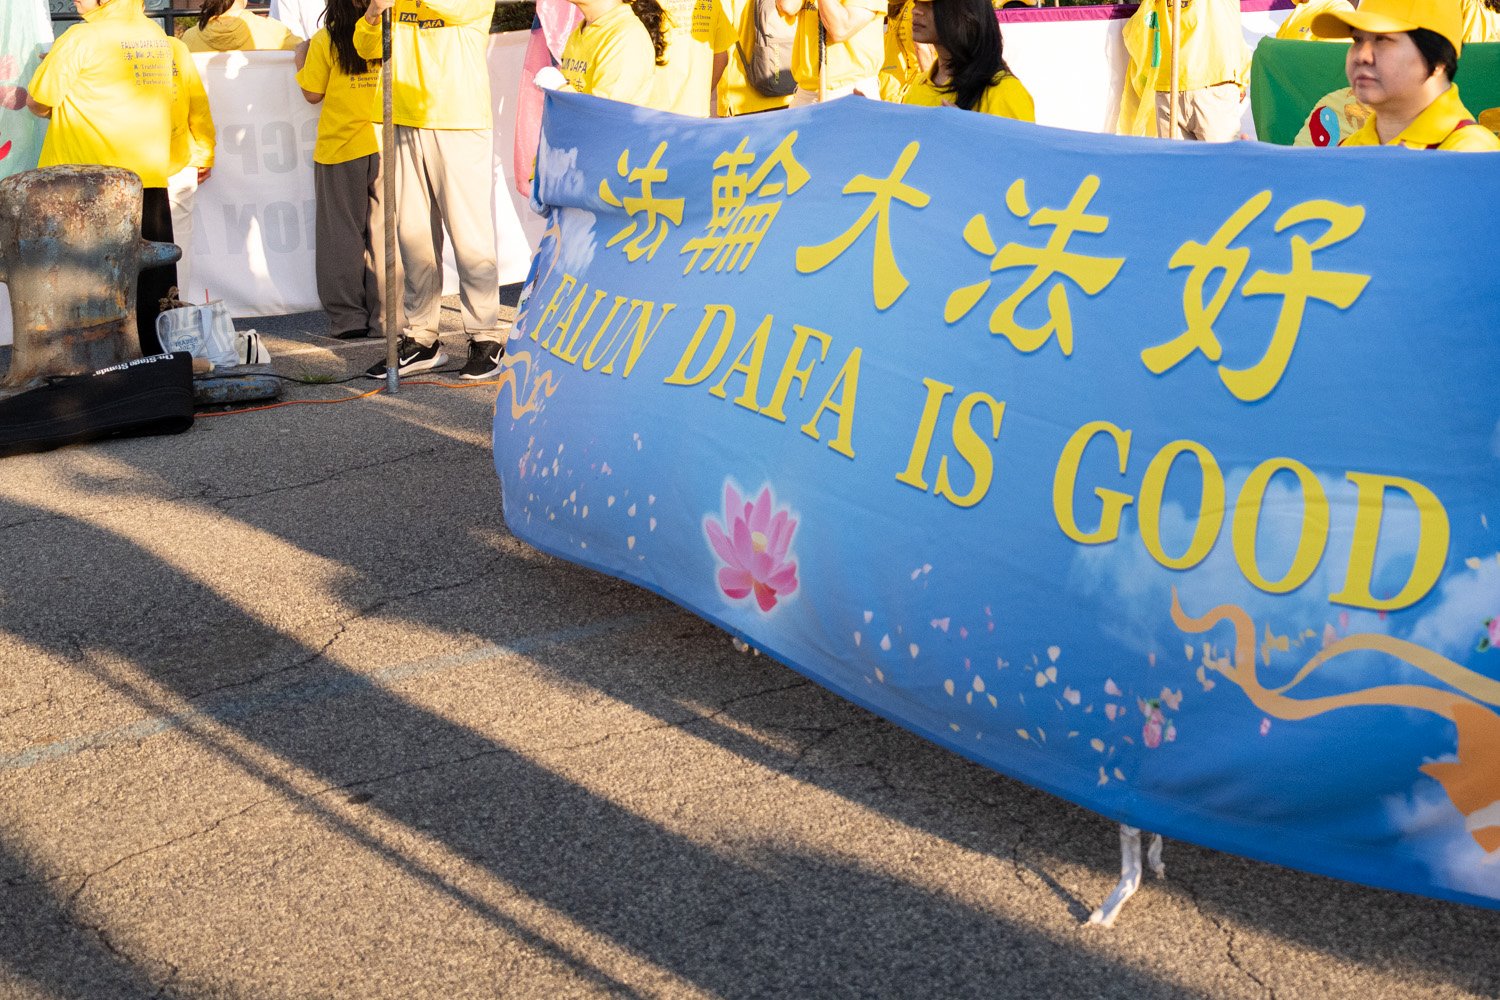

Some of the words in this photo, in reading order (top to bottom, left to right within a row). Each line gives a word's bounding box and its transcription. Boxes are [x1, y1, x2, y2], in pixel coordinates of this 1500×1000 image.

[598, 130, 1373, 403] 法輪大法好
[96, 363, 129, 376] Stands
[129, 353, 174, 366] On-Stage
[530, 272, 676, 379] FALUN
[663, 303, 864, 459] DAFA
[895, 377, 1007, 508] IS
[1052, 420, 1451, 612] GOOD
